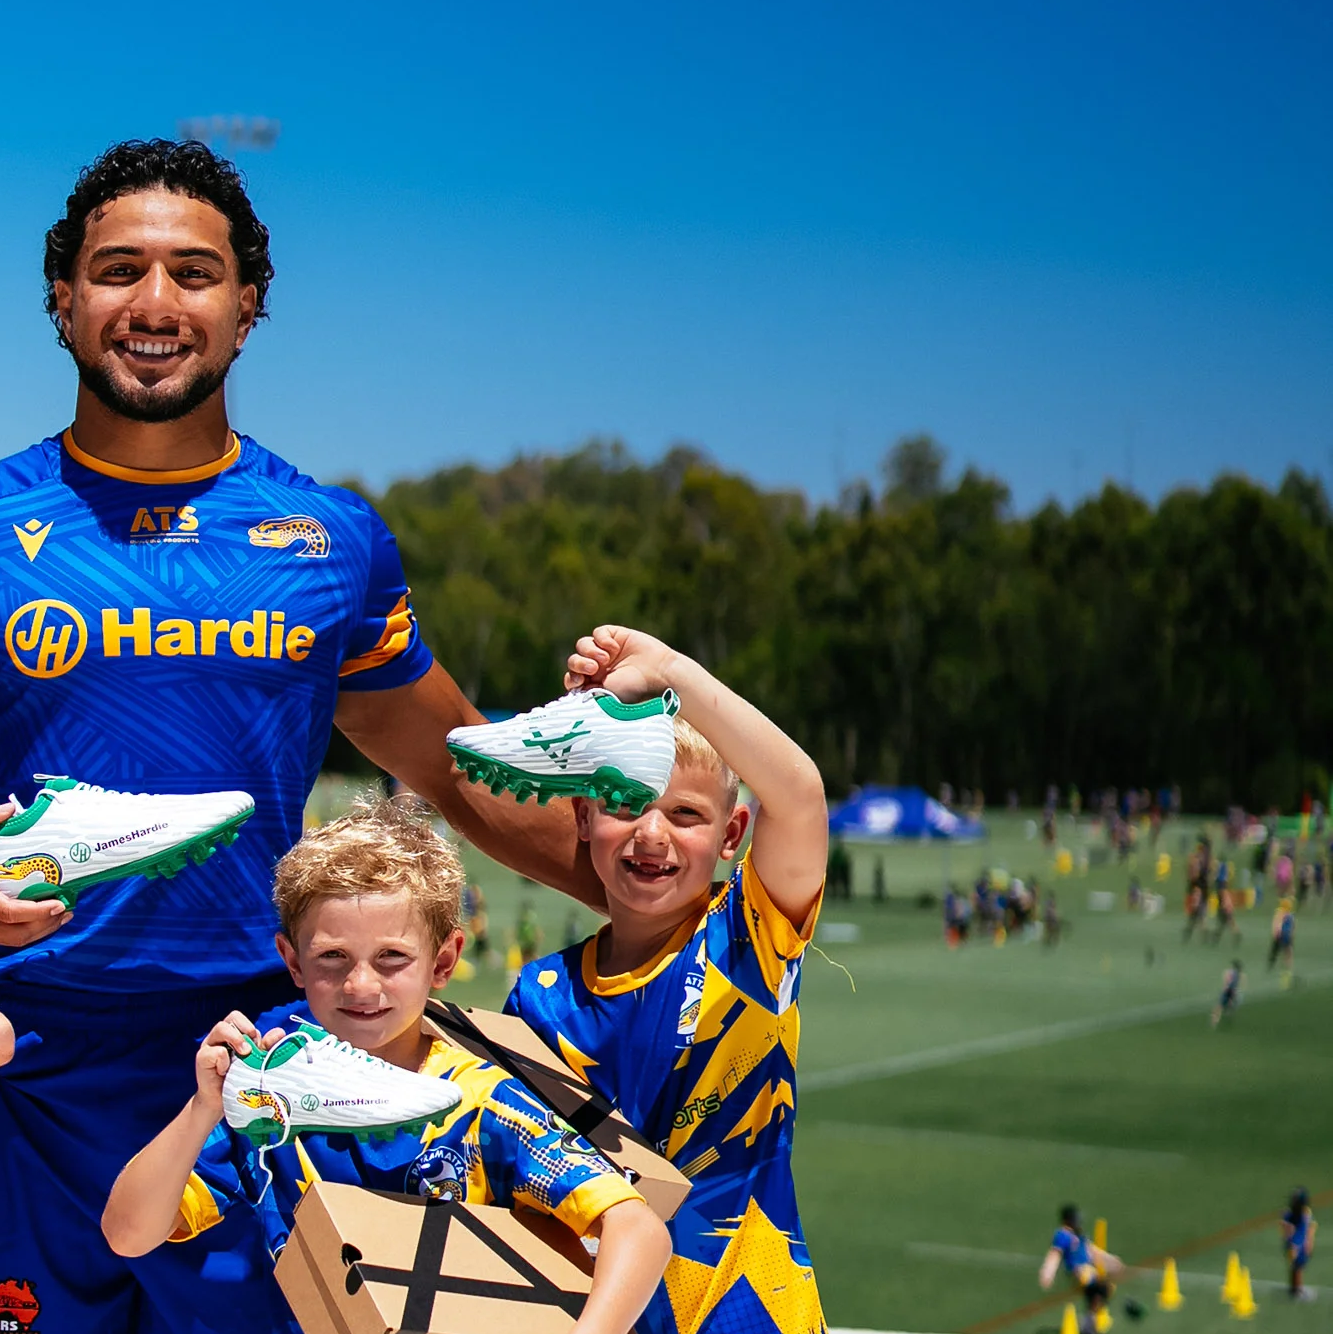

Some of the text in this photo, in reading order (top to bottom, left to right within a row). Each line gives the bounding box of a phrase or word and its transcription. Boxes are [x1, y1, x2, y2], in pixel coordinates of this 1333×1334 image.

[130, 506, 199, 532] ATS
[101, 608, 316, 662] Hardie
[94, 821, 170, 853] JamesHardie
[322, 1098, 390, 1108] JamesHardie
